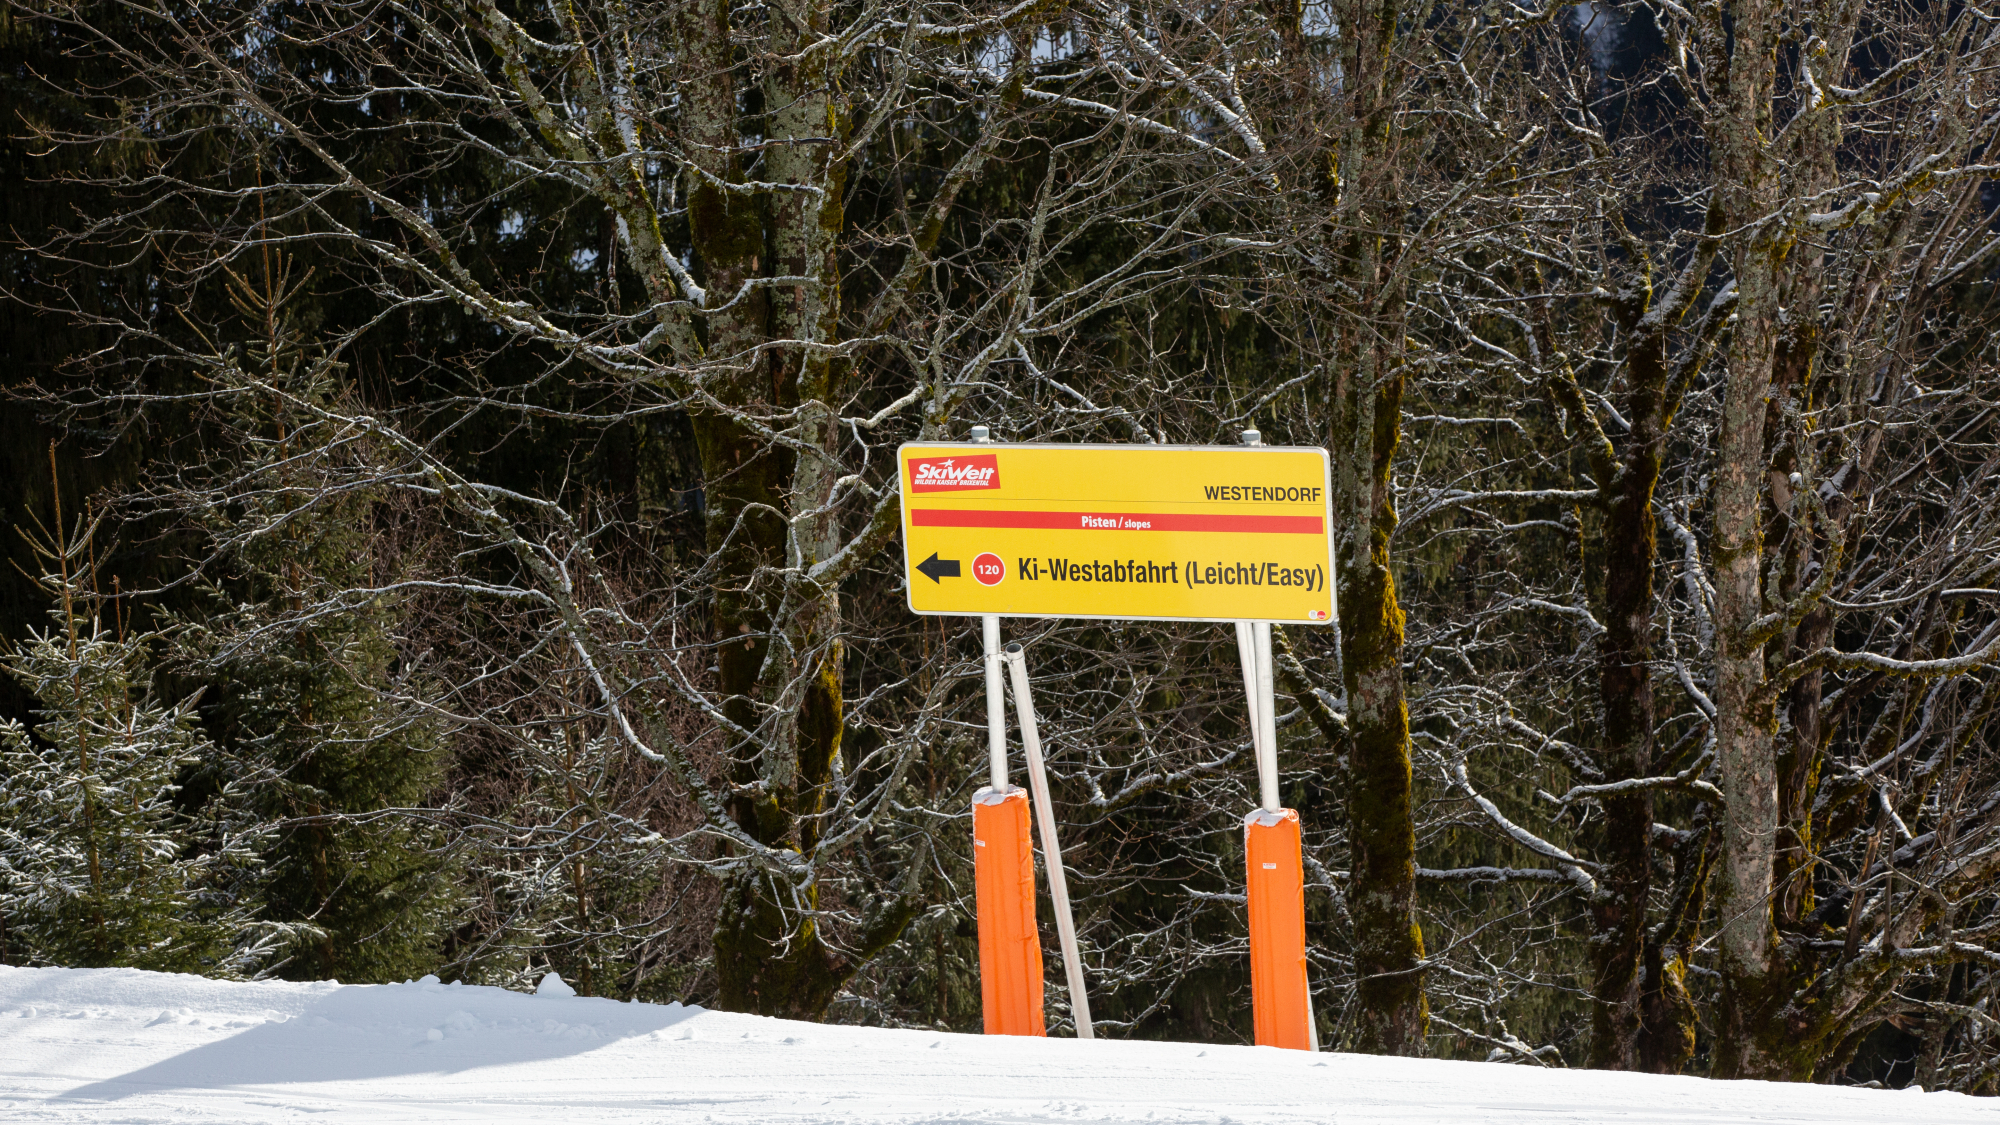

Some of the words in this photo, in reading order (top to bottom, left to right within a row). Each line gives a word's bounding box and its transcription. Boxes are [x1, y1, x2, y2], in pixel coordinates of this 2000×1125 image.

[915, 463, 995, 480] SkiWelt
[1204, 485, 1322, 502] WESTENDORF
[1081, 515, 1117, 529] Pisten
[1125, 519, 1151, 530] slopes
[978, 565, 1000, 576] 120
[1018, 557, 1178, 584] Ki-Westabfahrt
[1185, 560, 1324, 592] (Leicht/Easy)
